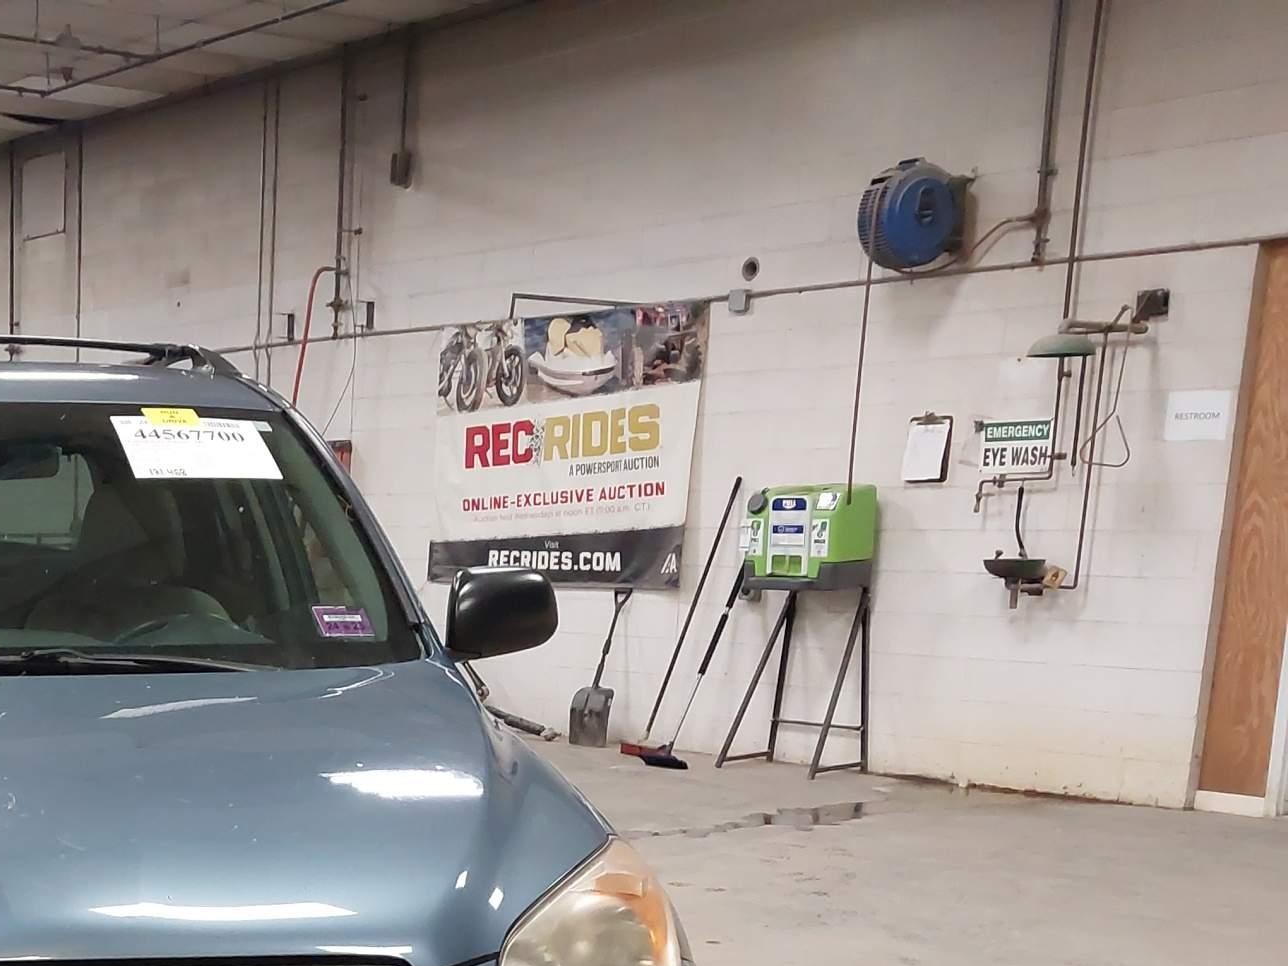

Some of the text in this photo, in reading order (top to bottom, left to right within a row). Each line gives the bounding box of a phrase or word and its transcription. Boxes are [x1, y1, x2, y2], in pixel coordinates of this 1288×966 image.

[1174, 412, 1221, 420] RESTROOM
[134, 428, 246, 442] 44567700
[464, 404, 661, 470] REC RIDES
[987, 424, 1049, 438] EMERGENCY
[569, 456, 660, 476] A POWERSPORT AUCTION
[983, 446, 1048, 467] EYE WASH
[462, 482, 666, 512] ONLINE-EXCLUSIVE AUCTION
[544, 540, 559, 549] Visit
[488, 550, 621, 571] RECRIDES.COM
